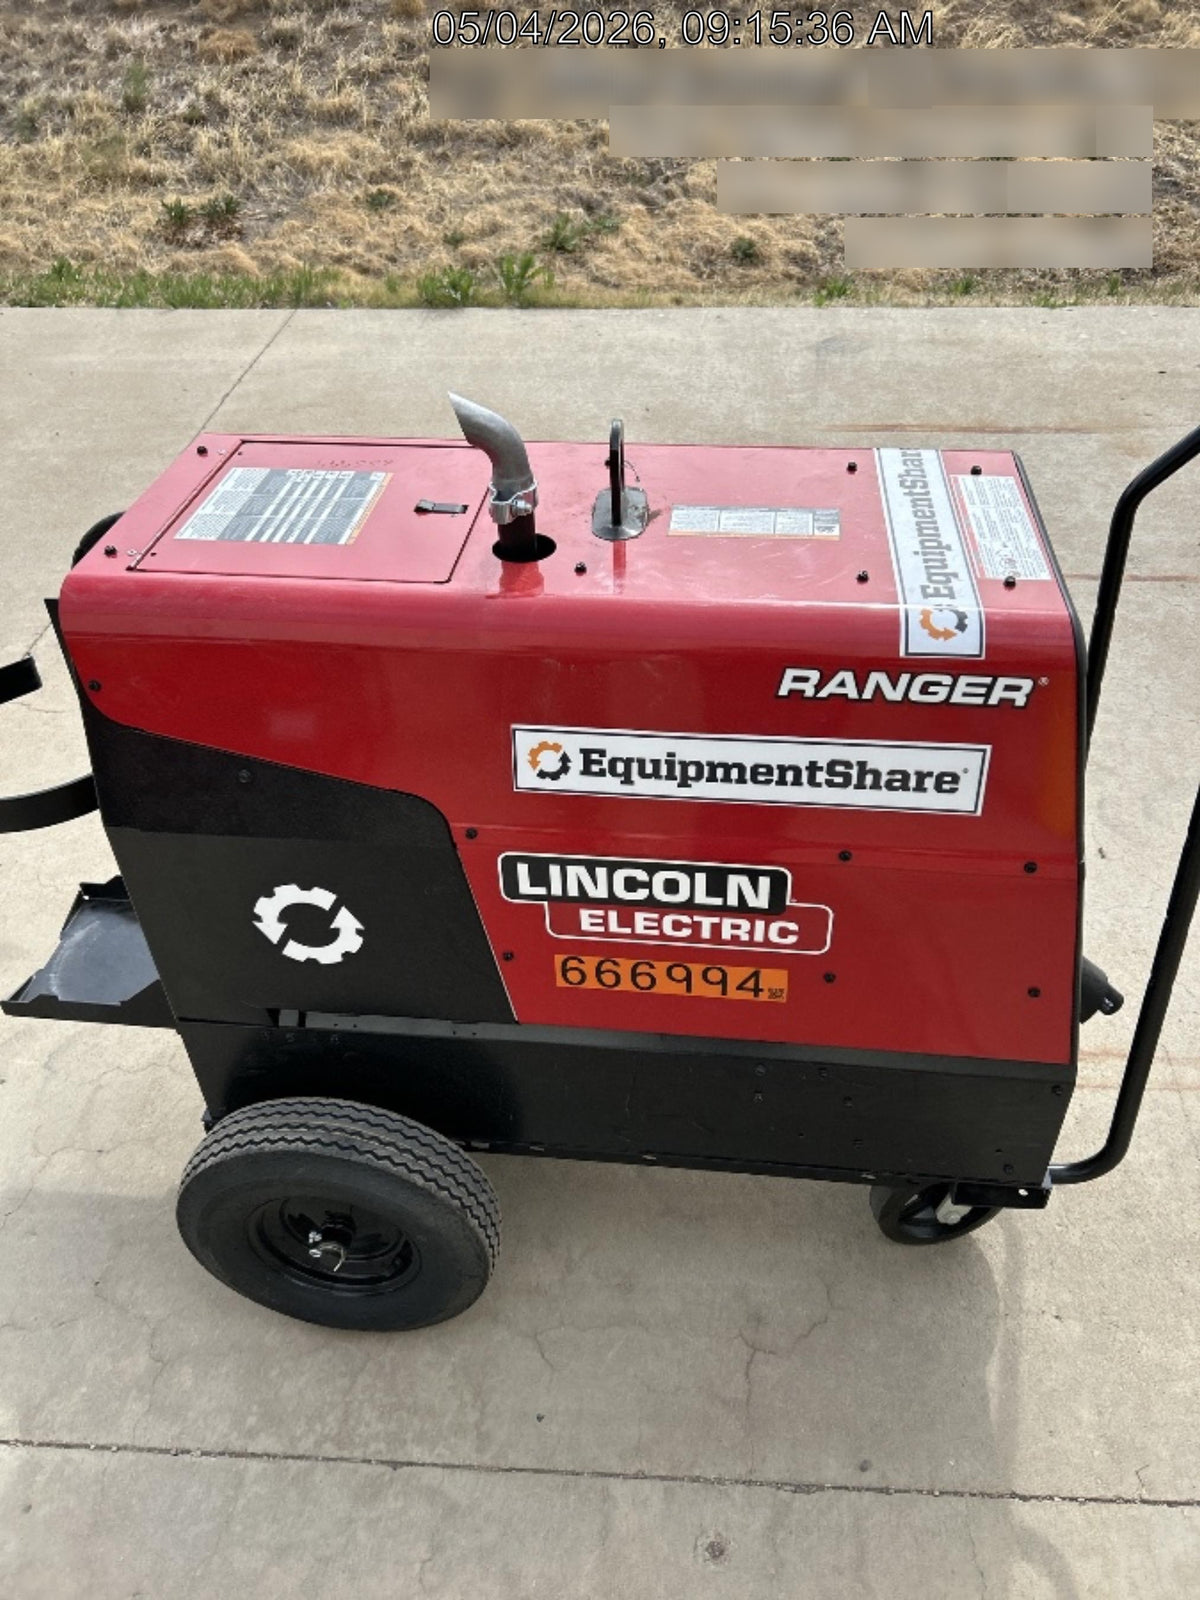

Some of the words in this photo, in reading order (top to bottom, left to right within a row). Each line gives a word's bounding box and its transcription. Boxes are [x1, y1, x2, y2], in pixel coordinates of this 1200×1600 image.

[897, 448, 959, 600] EquipmentShar
[579, 746, 961, 795] EquipmentShare
[516, 861, 771, 910] LINCOLN
[579, 908, 800, 945] ELECTRIC
[560, 954, 765, 998] 666994
